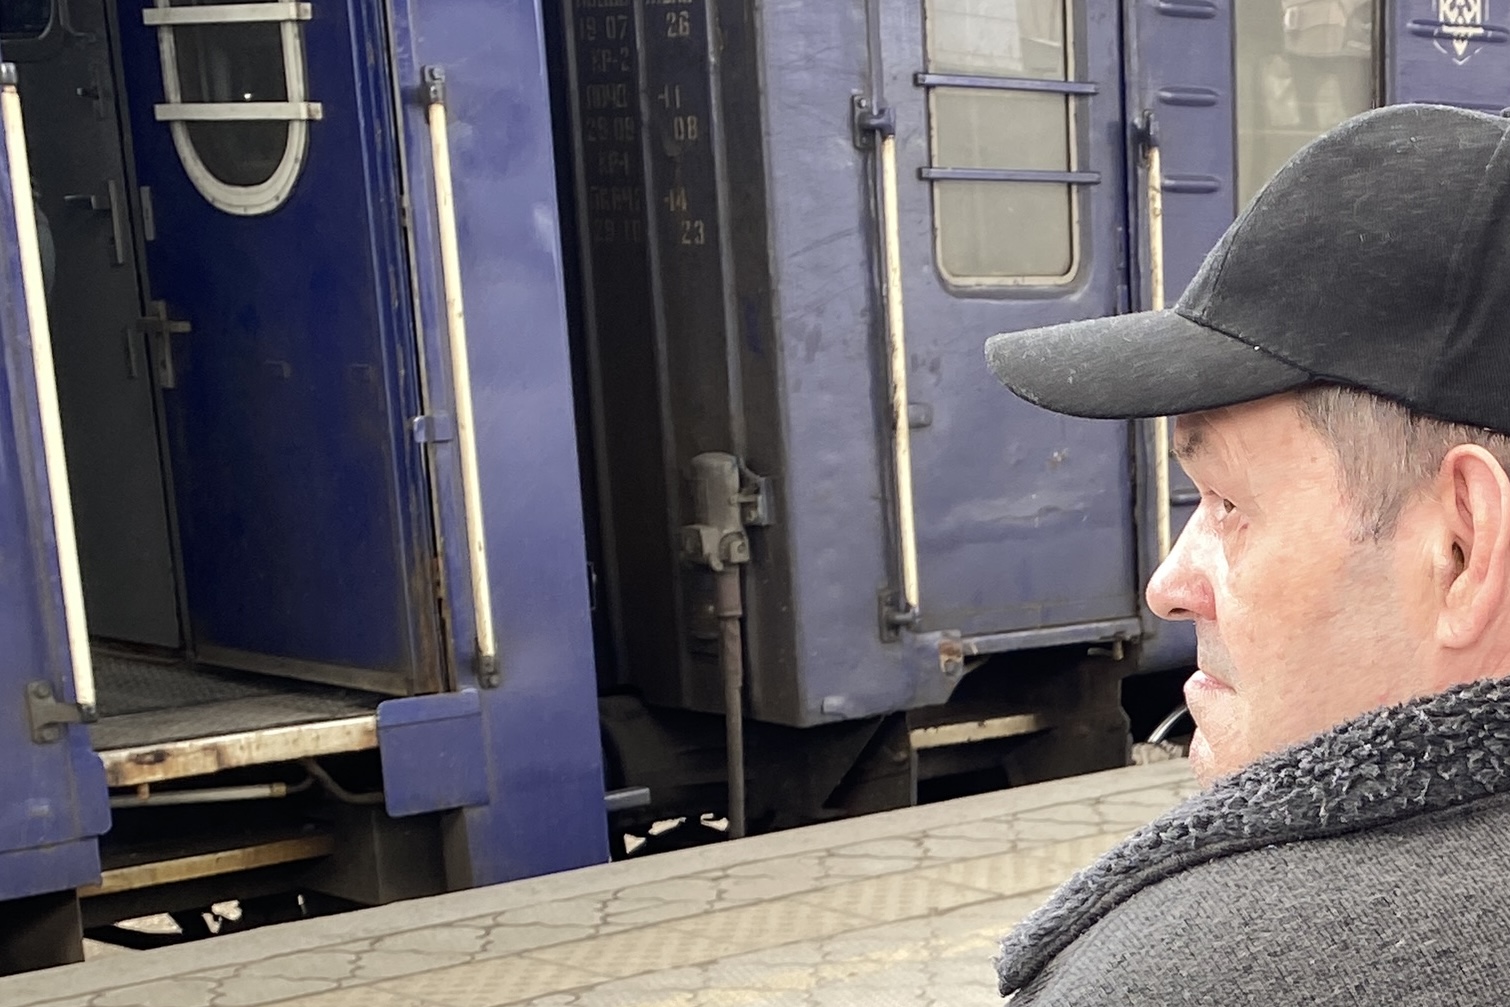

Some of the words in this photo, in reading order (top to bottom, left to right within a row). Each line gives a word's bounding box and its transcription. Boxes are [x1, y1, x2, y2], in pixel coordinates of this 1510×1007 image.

[606, 14, 628, 40] 07
[666, 10, 691, 38] 26
[674, 115, 698, 141] 08
[681, 219, 705, 244] 23
